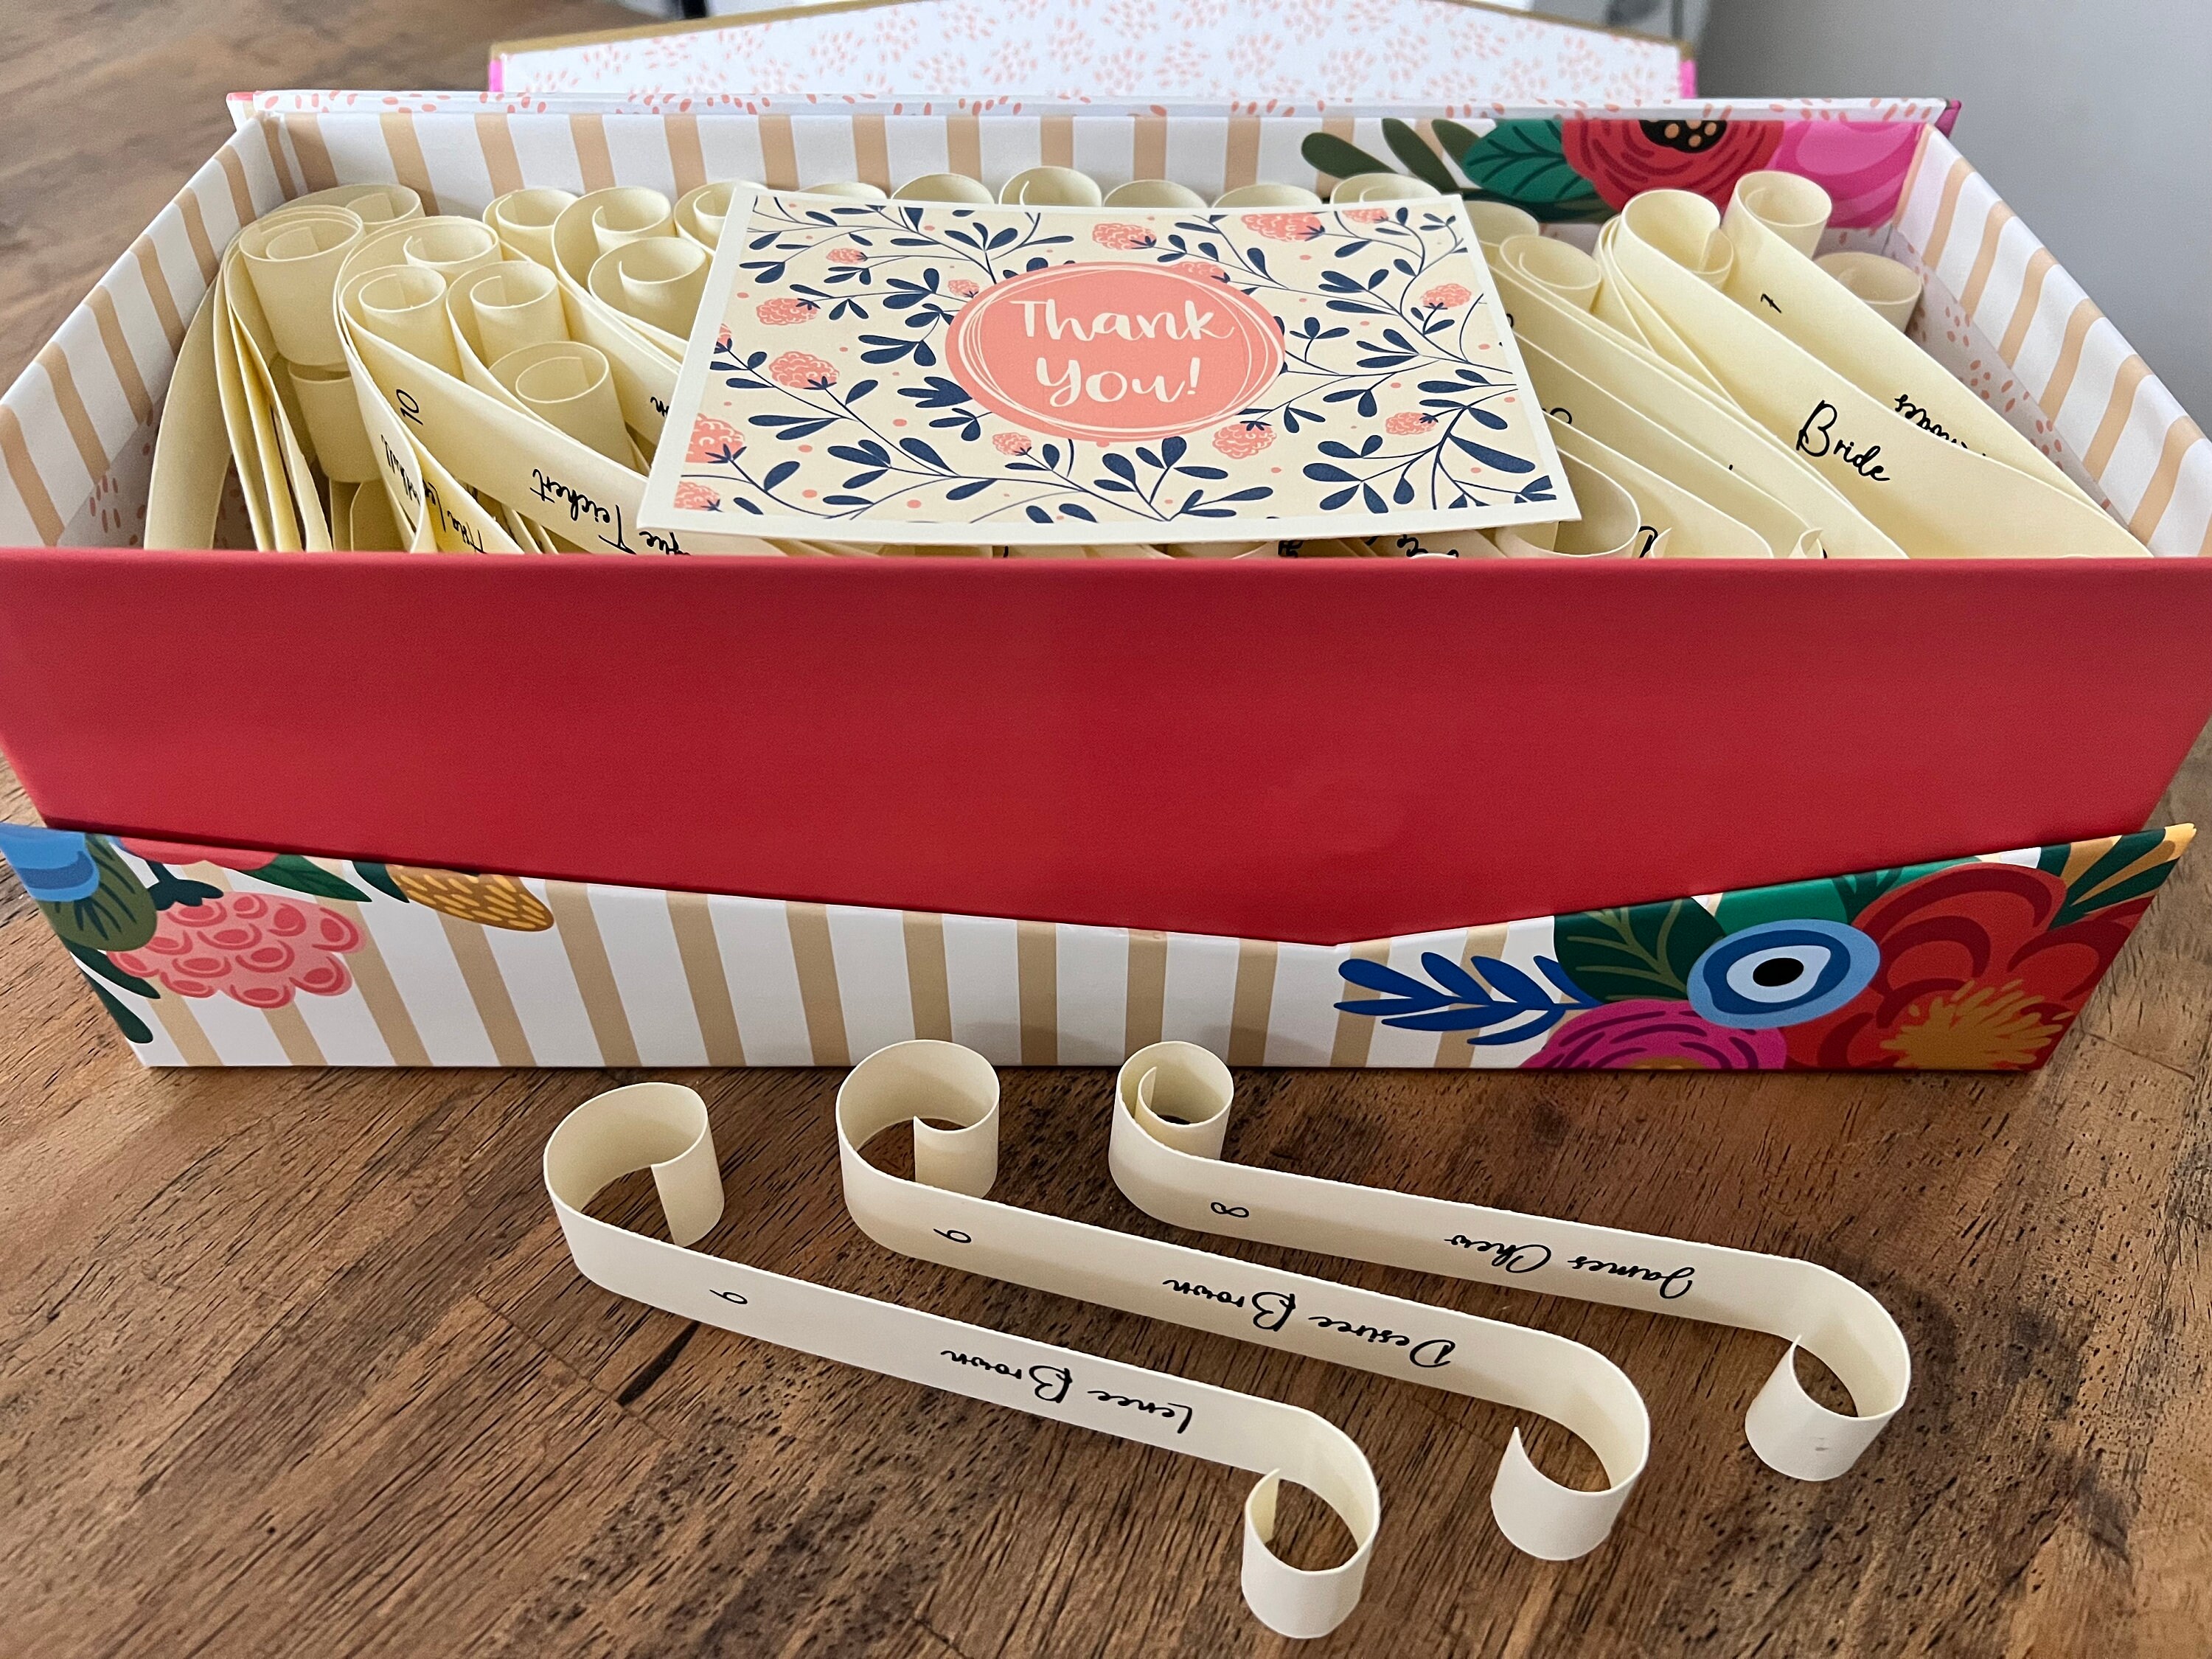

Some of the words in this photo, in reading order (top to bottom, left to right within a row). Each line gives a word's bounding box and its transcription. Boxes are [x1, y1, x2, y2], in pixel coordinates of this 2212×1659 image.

[1009, 297, 1237, 342] Thank
[1035, 356, 1202, 408] You!
[1795, 400, 1891, 481] Bride
[529, 467, 638, 556] Teichert
[1443, 1234, 1553, 1274] Chew
[1567, 1255, 1696, 1300] James
[1162, 1279, 1298, 1333] Brown
[1307, 1315, 1456, 1369] Desiree
[939, 1349, 1074, 1405] Brown
